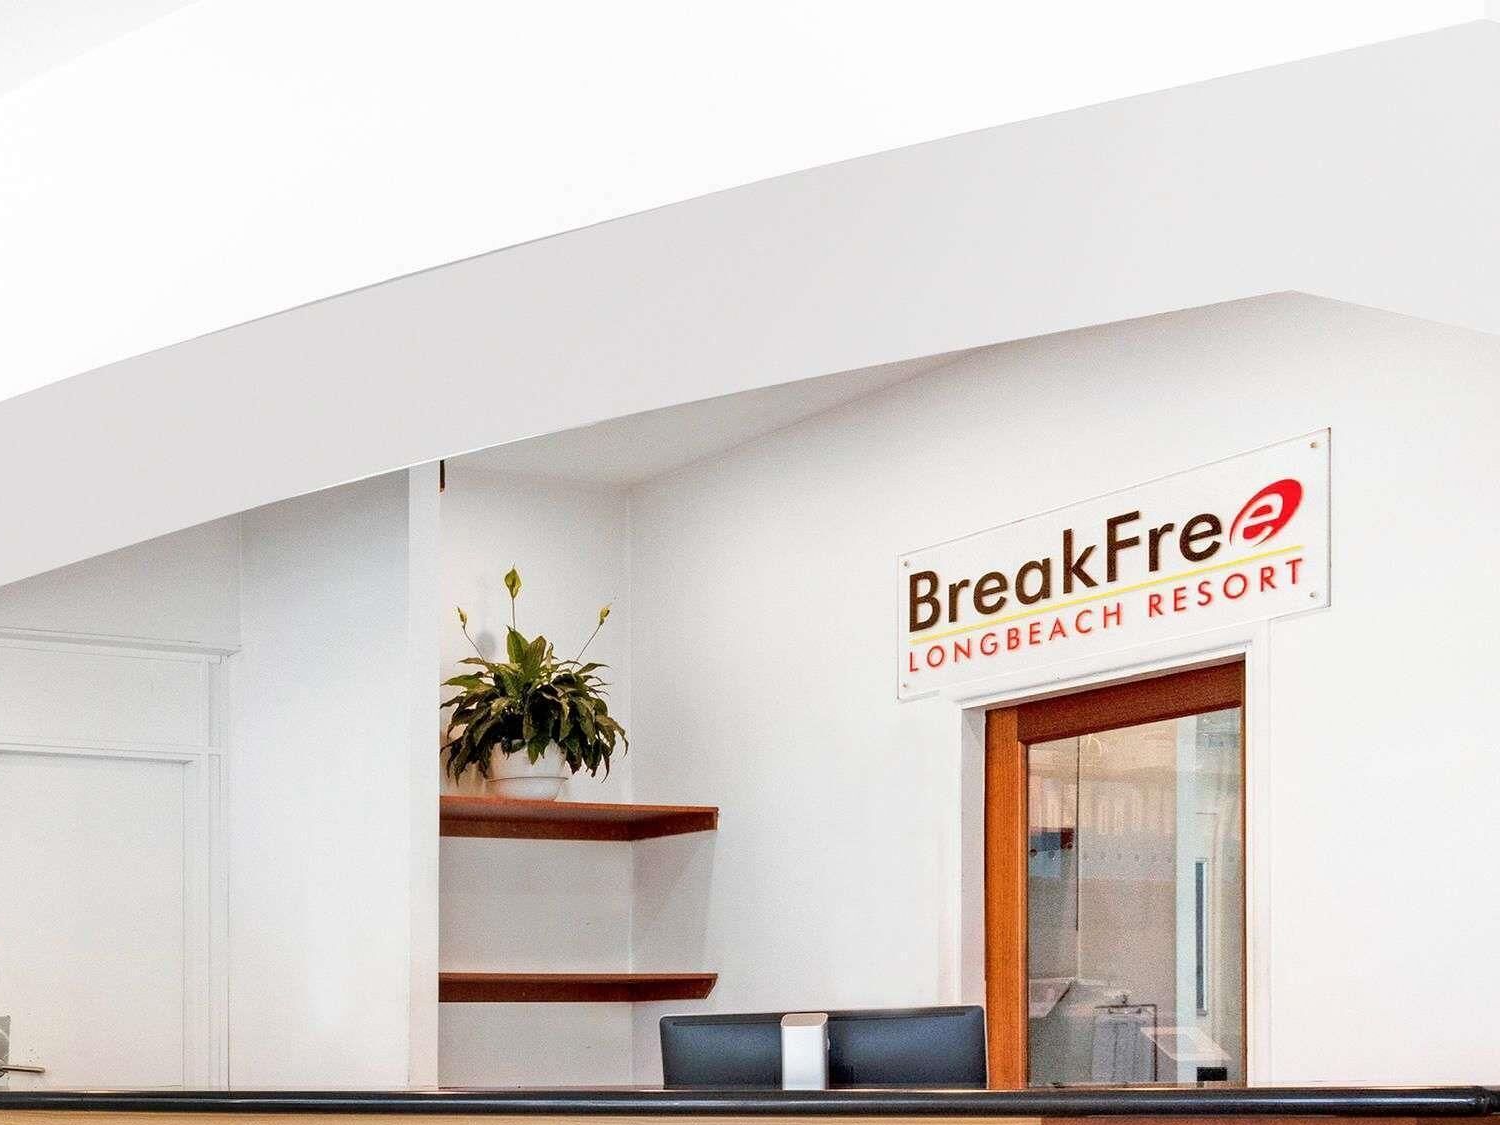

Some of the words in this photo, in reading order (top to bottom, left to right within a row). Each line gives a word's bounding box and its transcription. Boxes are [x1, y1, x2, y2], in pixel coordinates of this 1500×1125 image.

[908, 478, 1304, 633] BreakFree
[909, 602, 1123, 673] LONGBEACH
[1148, 557, 1305, 618] RESORT
